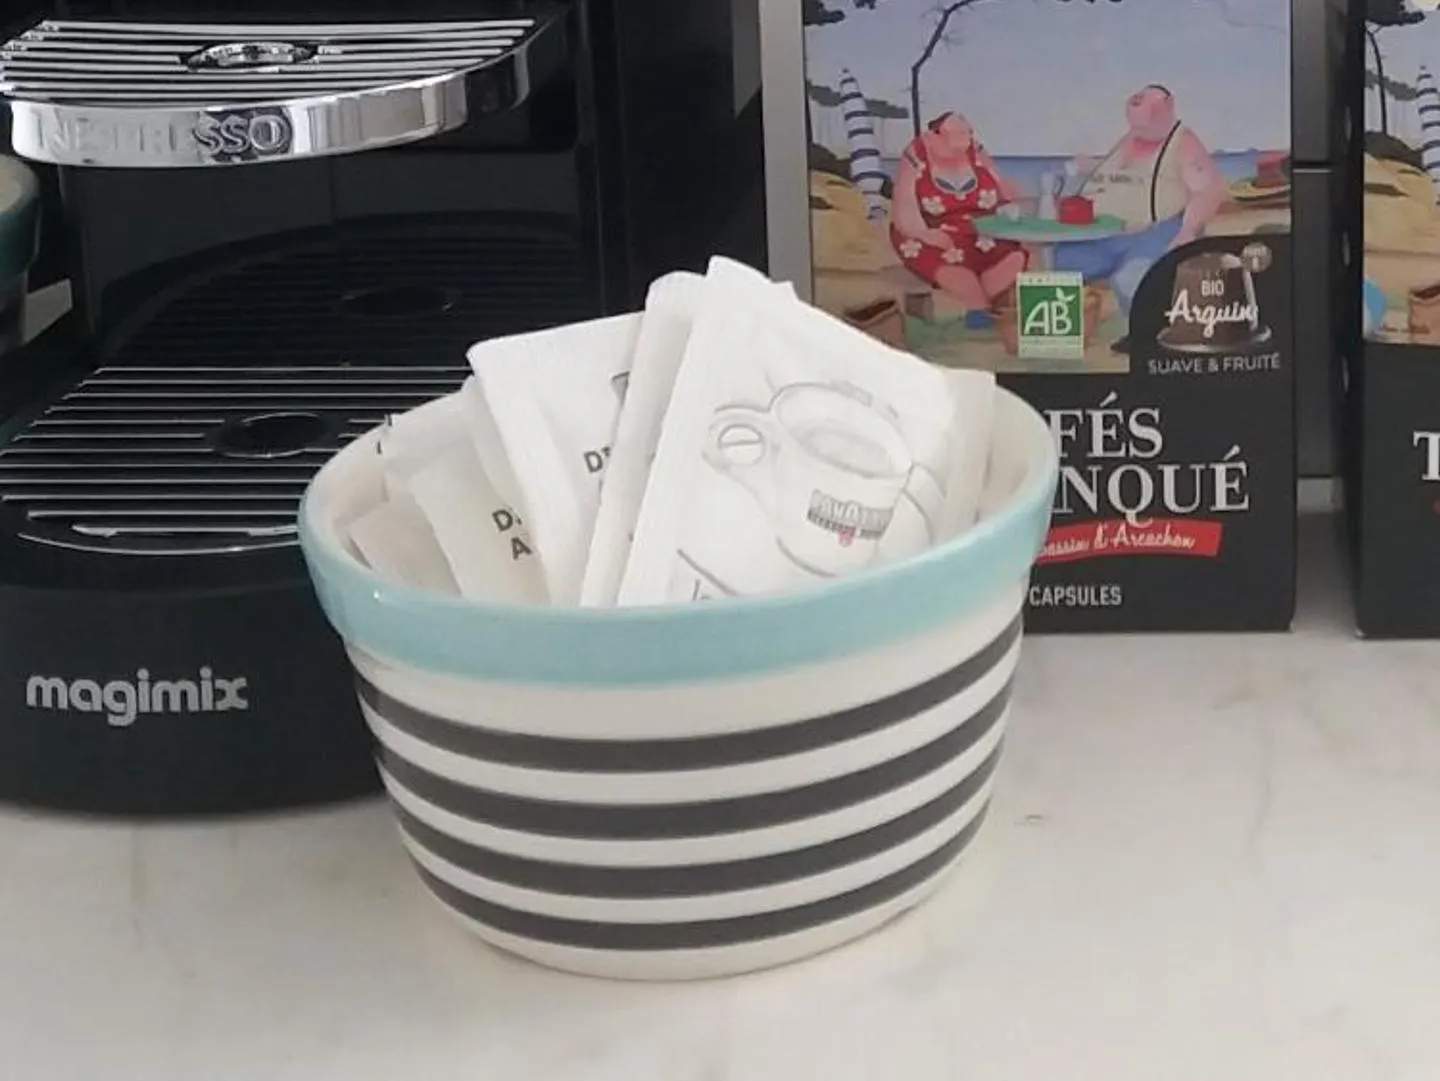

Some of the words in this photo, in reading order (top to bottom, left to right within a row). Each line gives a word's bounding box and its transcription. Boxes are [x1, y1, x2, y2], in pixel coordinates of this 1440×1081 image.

[1201, 279, 1225, 297] BIO
[1023, 300, 1073, 335] AB
[1164, 288, 1259, 338] Arguin
[1148, 358, 1202, 375] SUAVE
[1044, 391, 1163, 458] FÉS
[1050, 444, 1249, 528] NQUÉ
[1038, 536, 1089, 557] assin
[1029, 584, 1122, 607] CAPSULES
[26, 666, 249, 727] magimix
